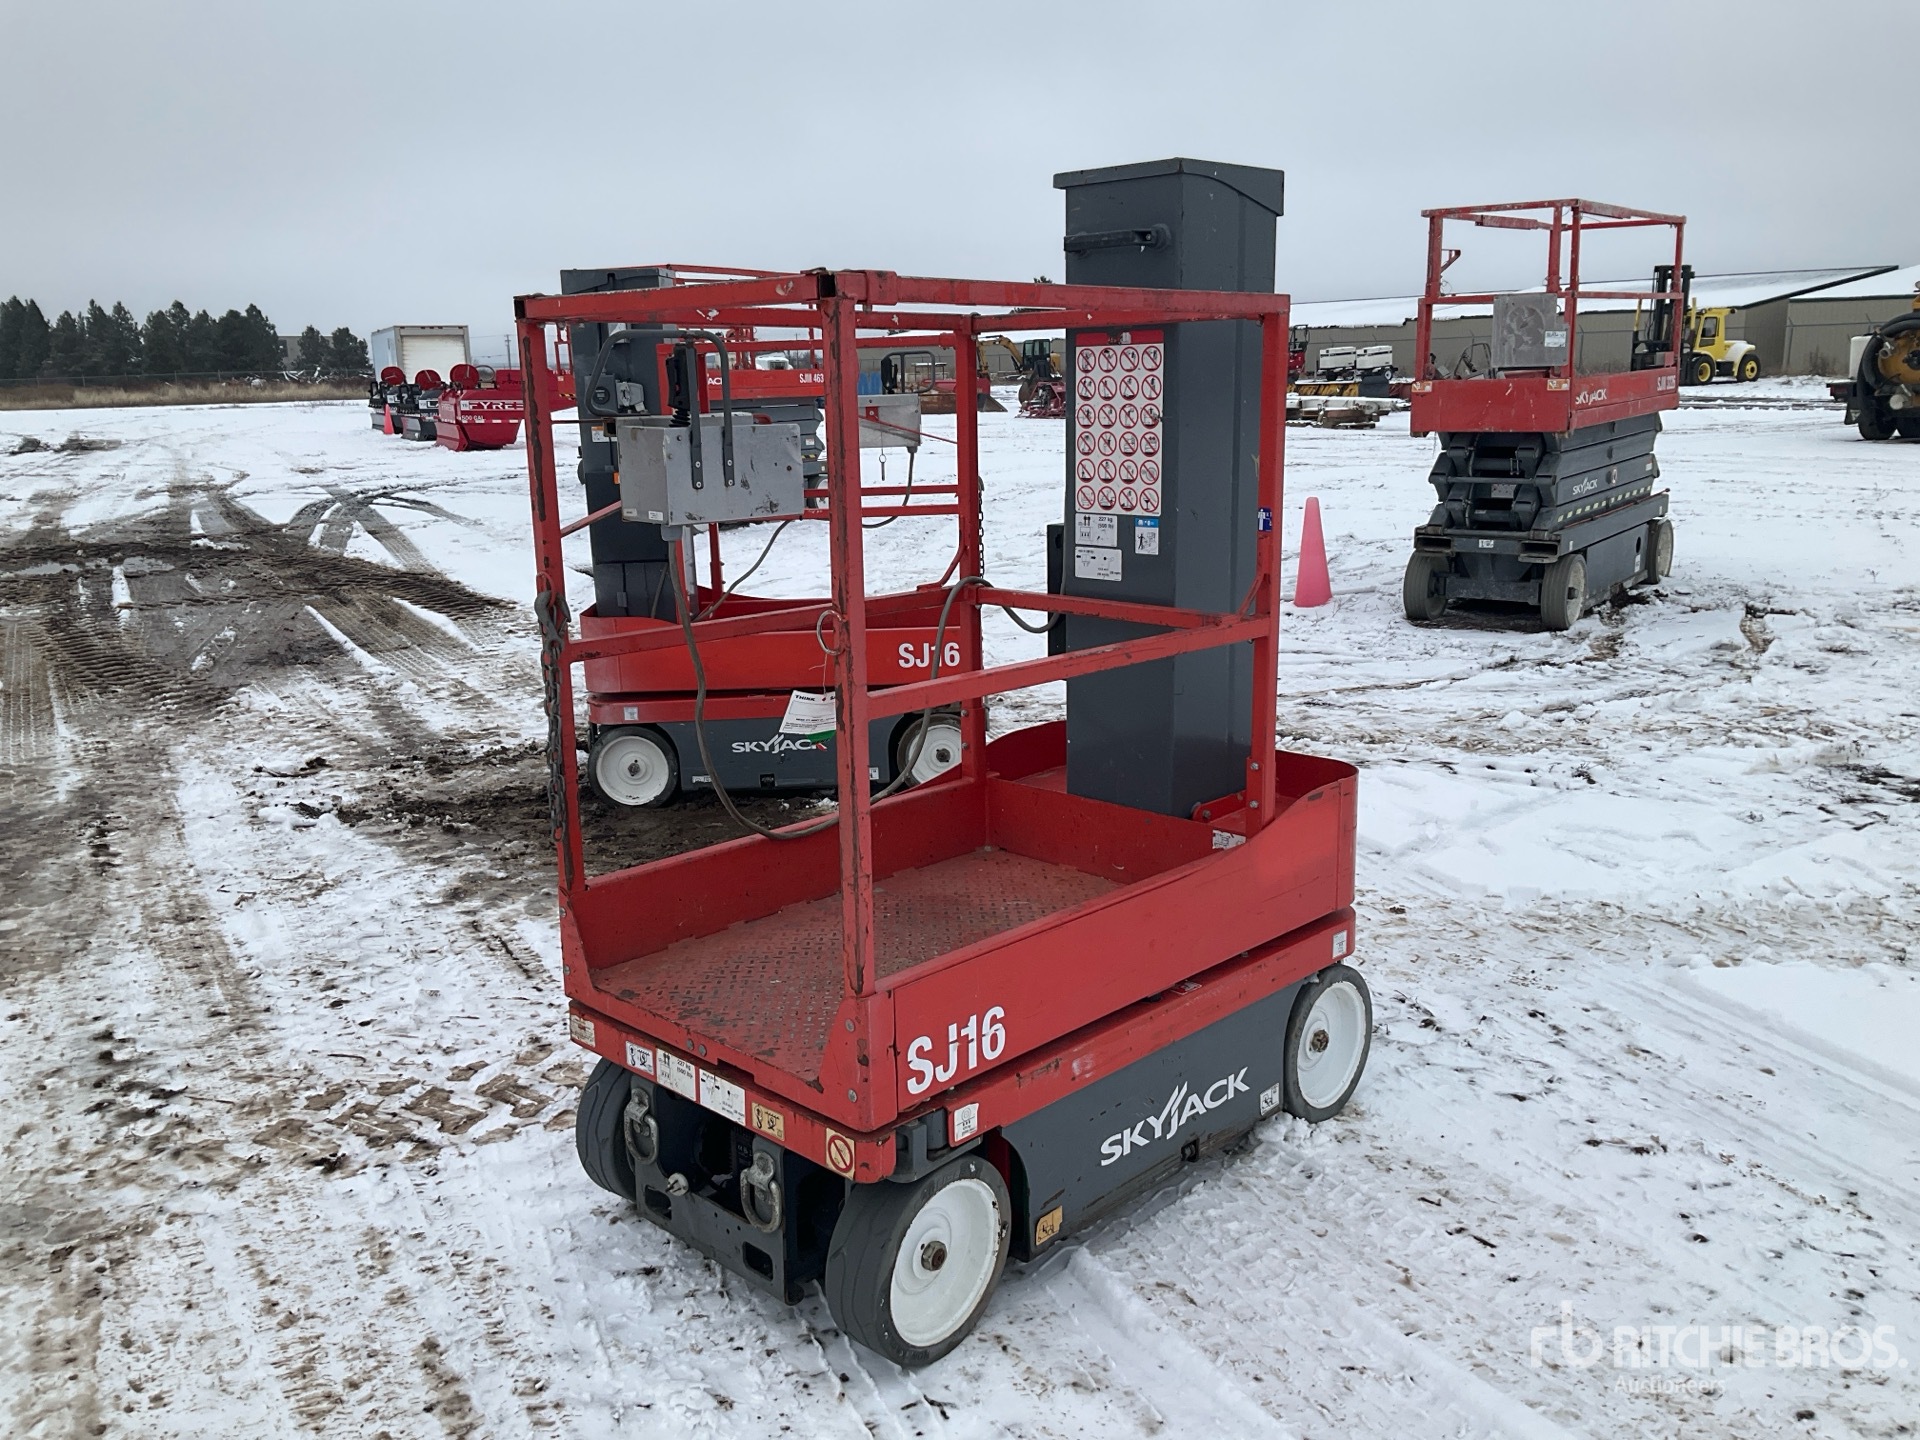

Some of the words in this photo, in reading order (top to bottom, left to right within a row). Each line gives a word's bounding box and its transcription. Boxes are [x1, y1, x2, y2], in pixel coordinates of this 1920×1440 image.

[813, 373, 824, 383] 463
[1575, 388, 1607, 405] SKYJACK
[1572, 476, 1598, 496] SKYJACK
[906, 1005, 1006, 1095] SJ16
[1100, 1066, 1250, 1167] SKYJACK
